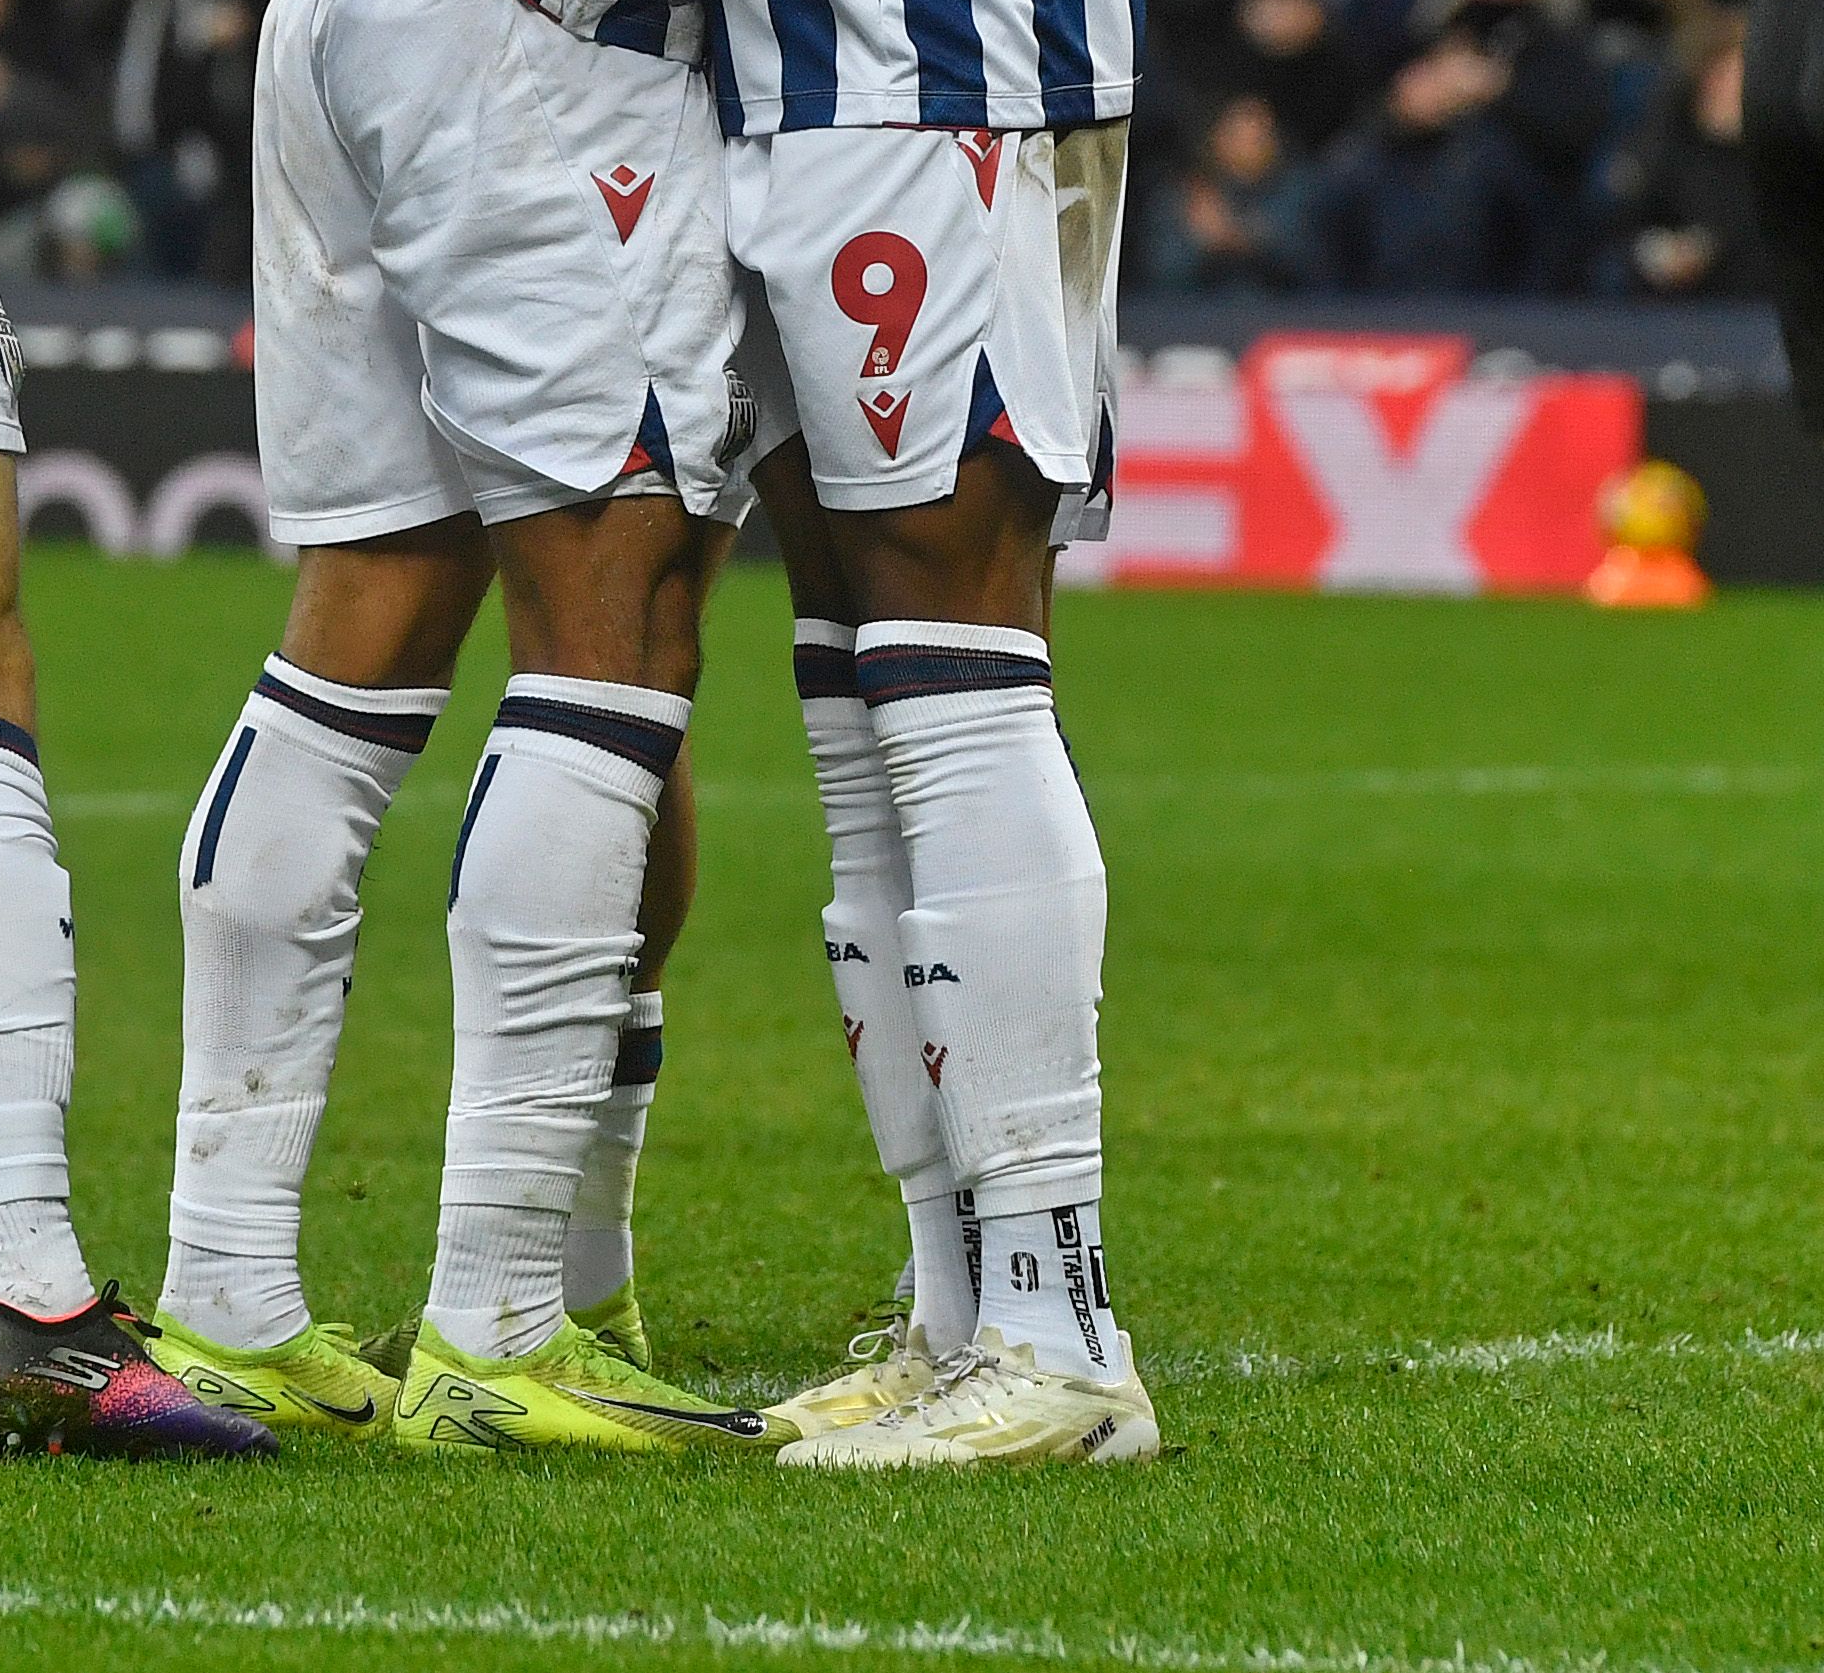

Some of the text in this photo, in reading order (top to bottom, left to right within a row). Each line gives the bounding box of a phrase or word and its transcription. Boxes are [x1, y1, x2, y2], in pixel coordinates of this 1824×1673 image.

[830, 230, 928, 378] 9
[1062, 1248, 1108, 1369] TAPEDESIGN
[1081, 1414, 1118, 1453] NINE
